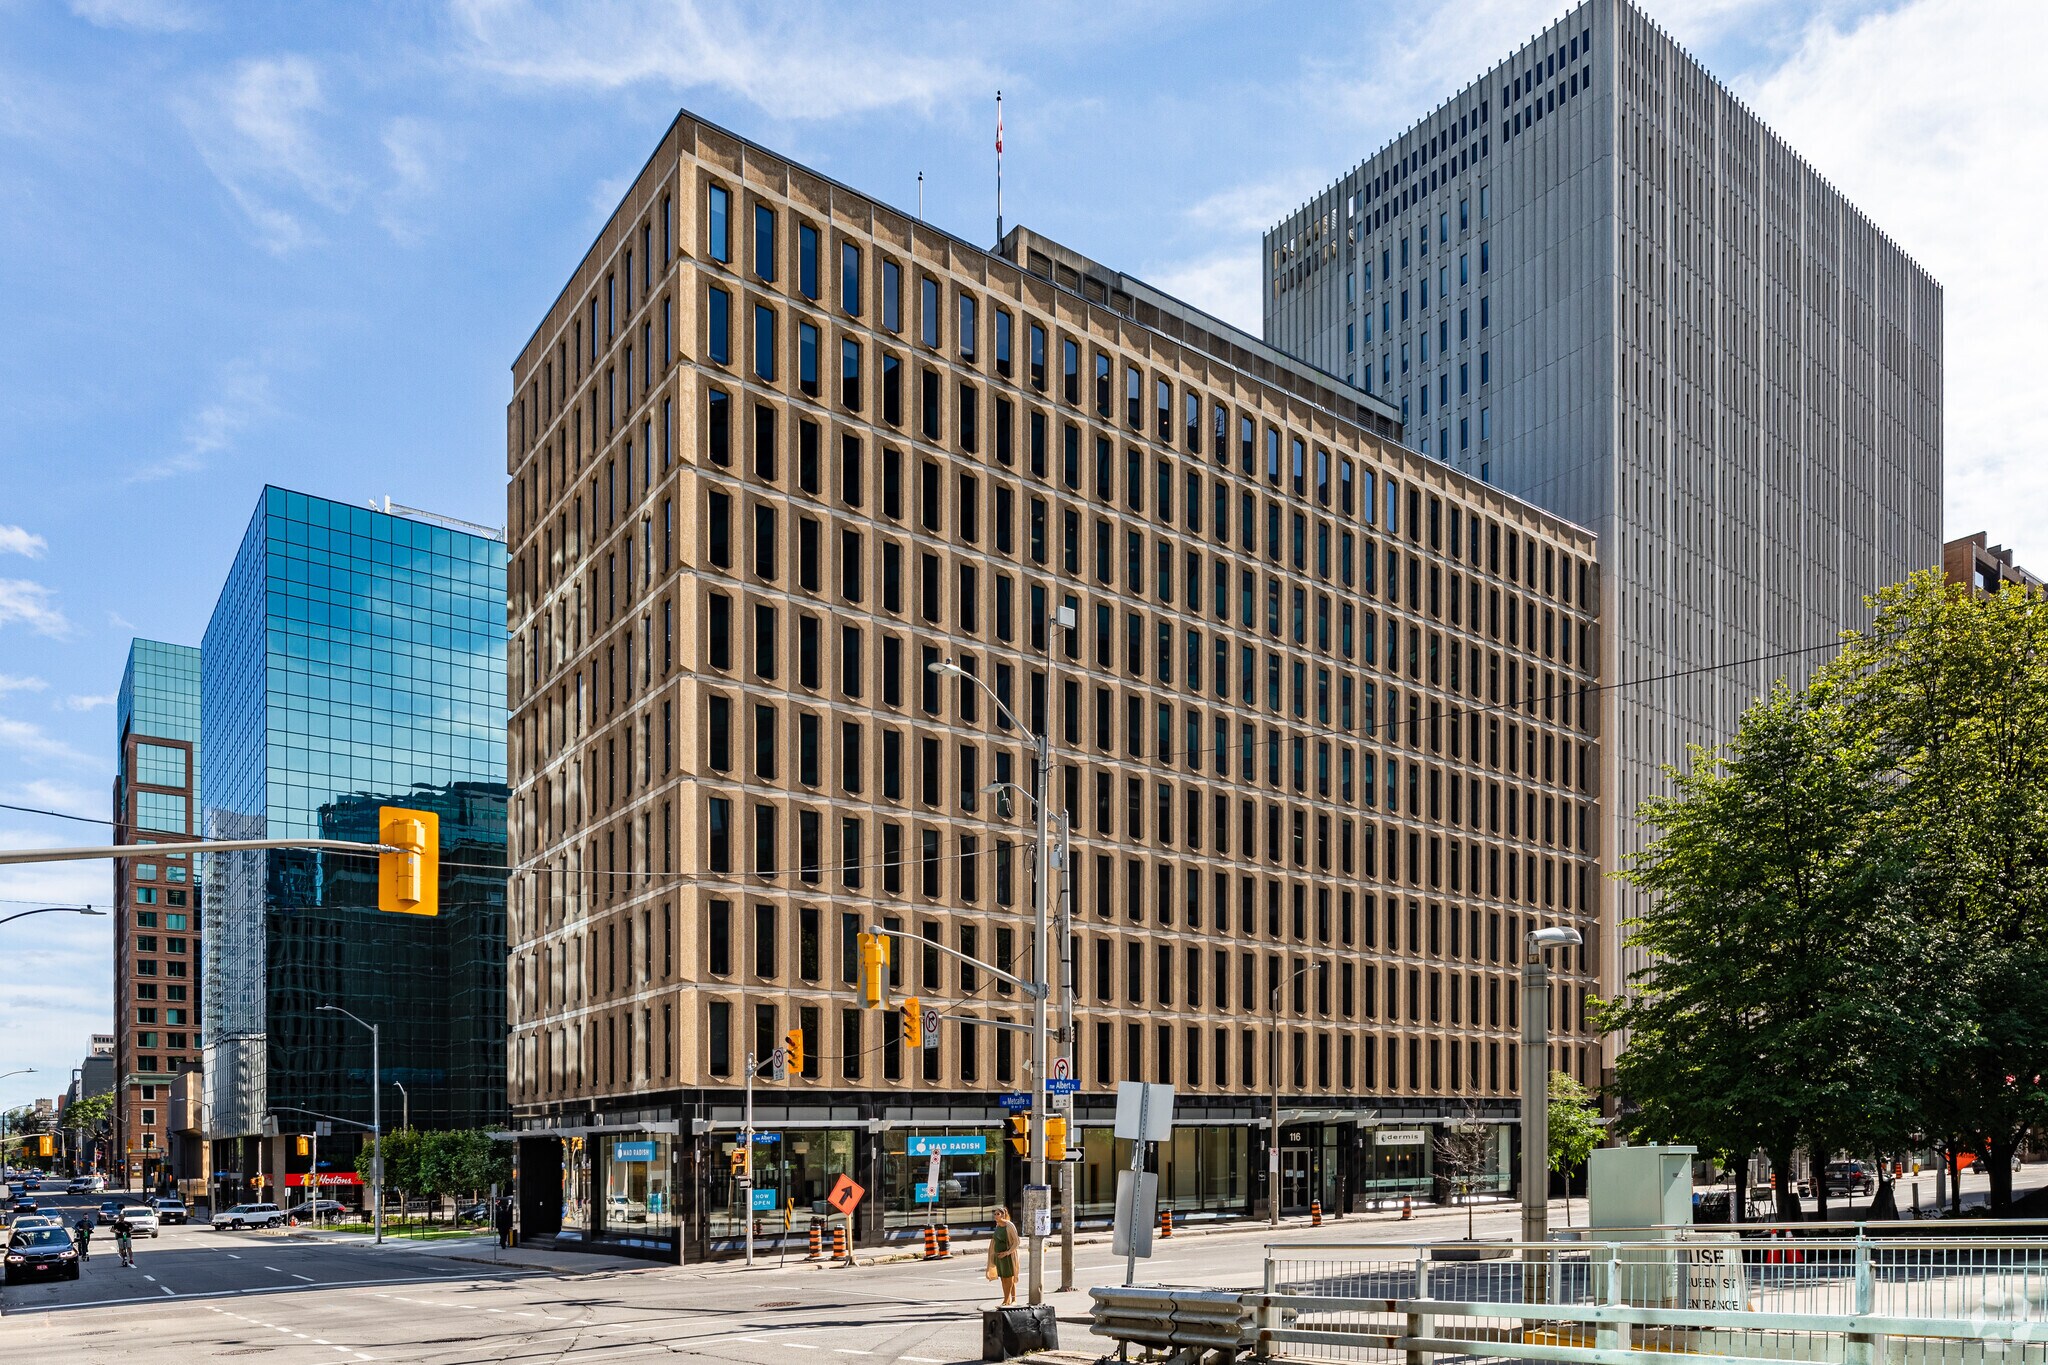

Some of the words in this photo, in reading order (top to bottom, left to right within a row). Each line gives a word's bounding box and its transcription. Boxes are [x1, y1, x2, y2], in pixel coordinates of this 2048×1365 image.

[1056, 1081, 1071, 1089] Albert
[1007, 1097, 1025, 1105] Metcalfe
[1290, 1132, 1301, 1142] 116
[319, 1174, 353, 1185] Hortons
[1689, 1250, 1725, 1267] USE
